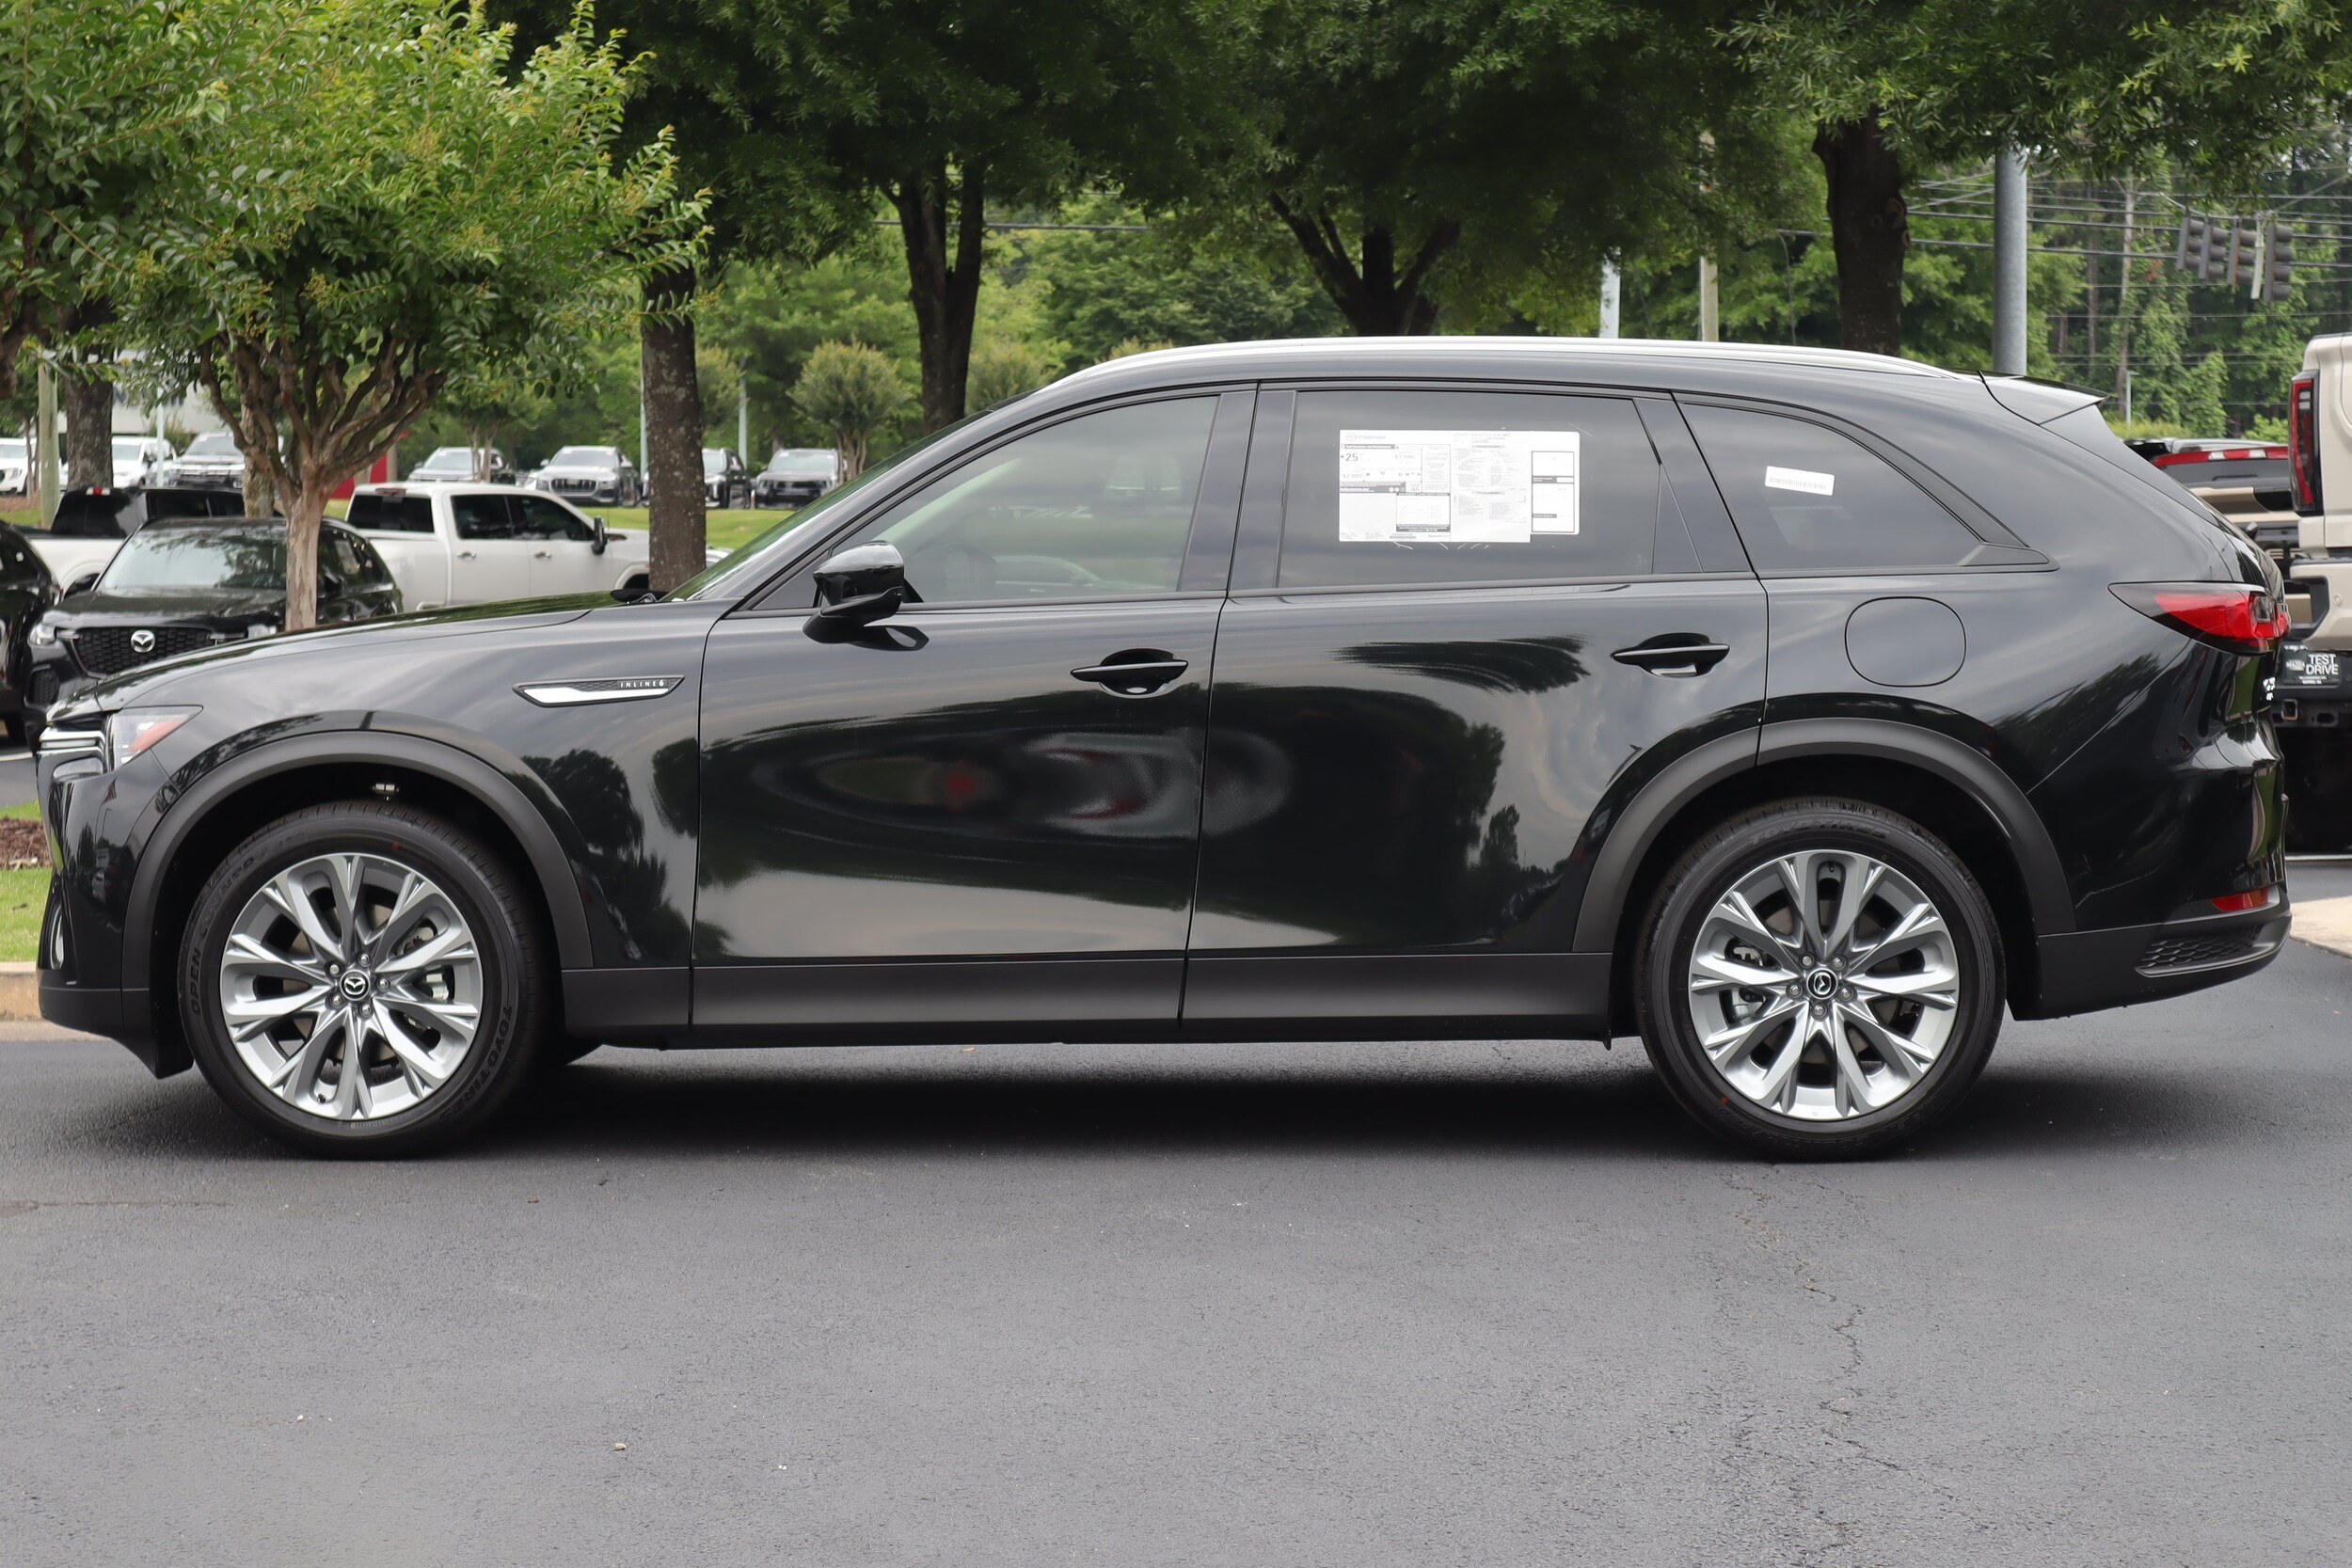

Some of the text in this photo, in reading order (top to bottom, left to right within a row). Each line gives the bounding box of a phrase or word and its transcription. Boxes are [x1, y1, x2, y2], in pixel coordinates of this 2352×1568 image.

[1345, 452, 1359, 461] 25
[2308, 654, 2337, 664] TEST
[2306, 664, 2339, 675] DRIVE
[189, 949, 202, 1013] OPEN
[486, 1005, 513, 1068] TOYO
